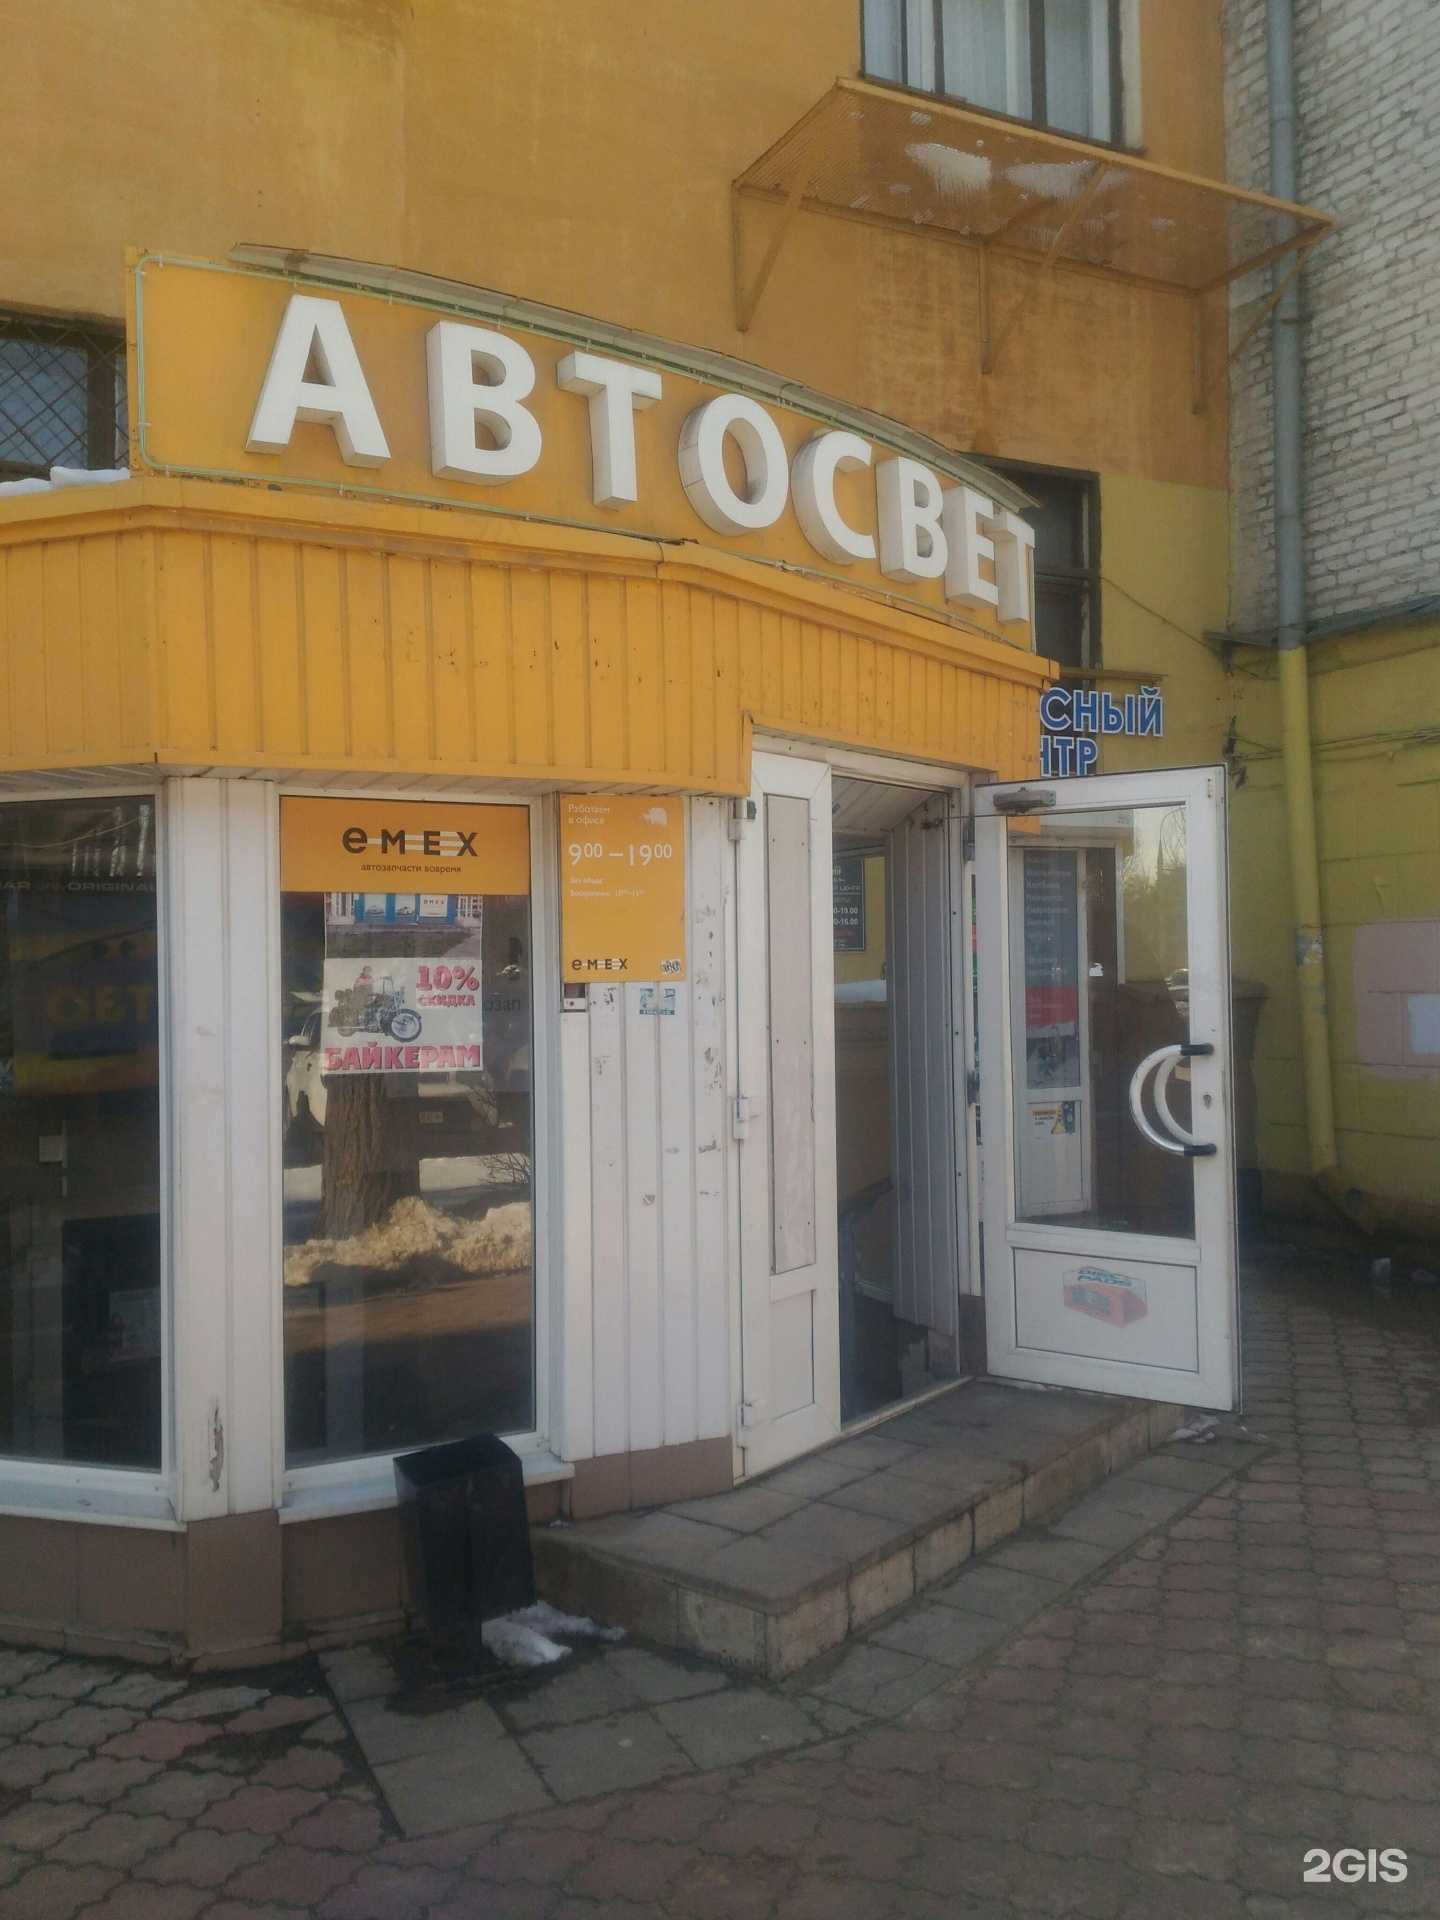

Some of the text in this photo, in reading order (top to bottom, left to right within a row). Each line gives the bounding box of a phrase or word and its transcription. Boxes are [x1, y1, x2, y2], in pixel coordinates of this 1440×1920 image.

[246, 294, 1036, 624] АВТОСВЕТ
[1040, 685, 1163, 737] СНЫЙ
[360, 863, 462, 873] автозапчасти вовремя
[416, 965, 480, 991] 10%
[417, 994, 476, 1008] СКИДКА
[324, 1042, 481, 1071] БАЙКЕРАМ
